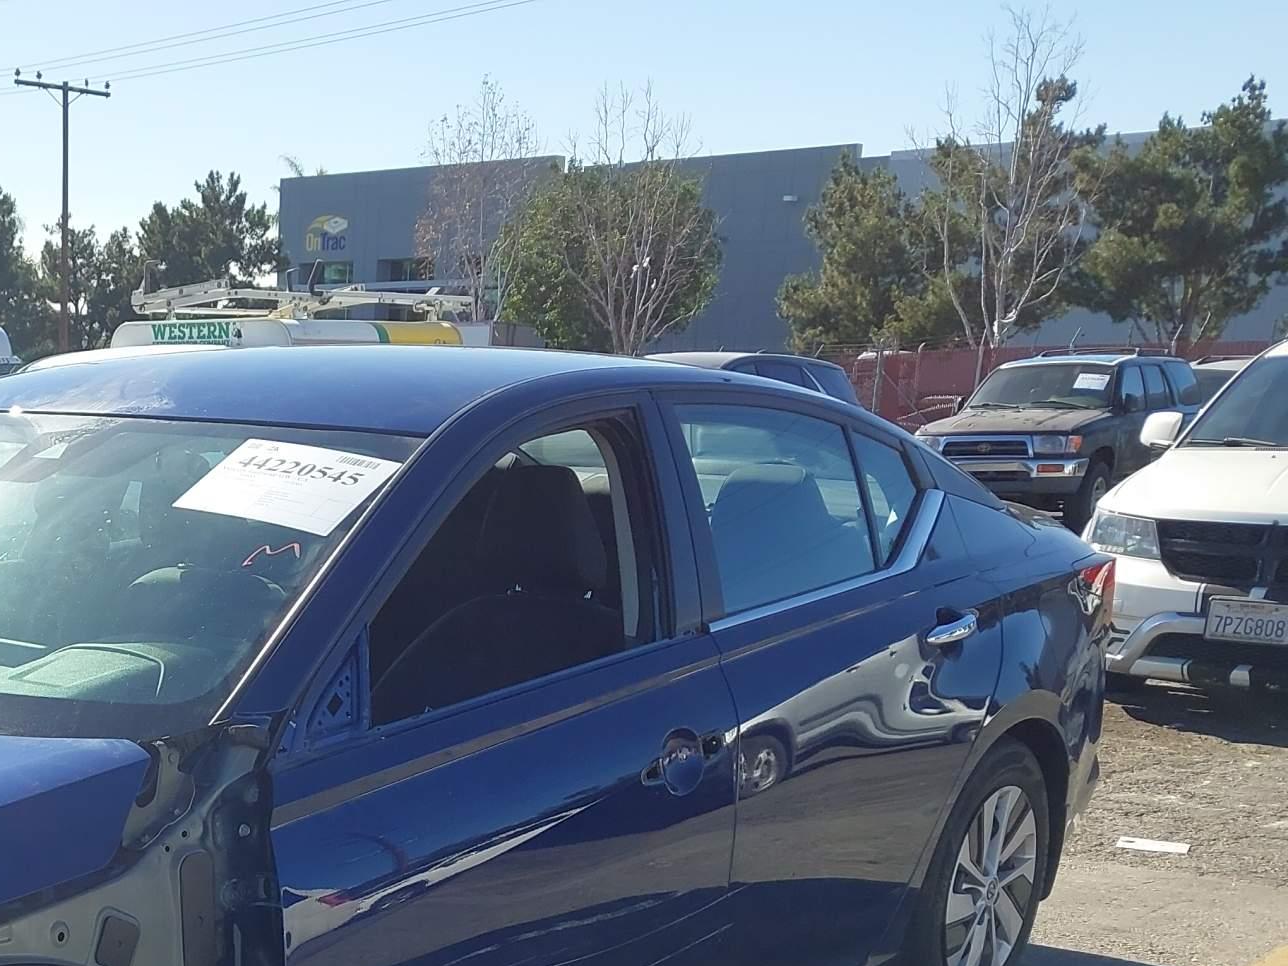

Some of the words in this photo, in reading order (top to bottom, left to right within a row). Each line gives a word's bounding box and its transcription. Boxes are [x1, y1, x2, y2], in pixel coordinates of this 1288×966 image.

[306, 231, 346, 251] OnTrac
[152, 322, 231, 340] WESTERN
[239, 455, 365, 486] 44220545
[1214, 615, 1286, 638] 7PZG808
